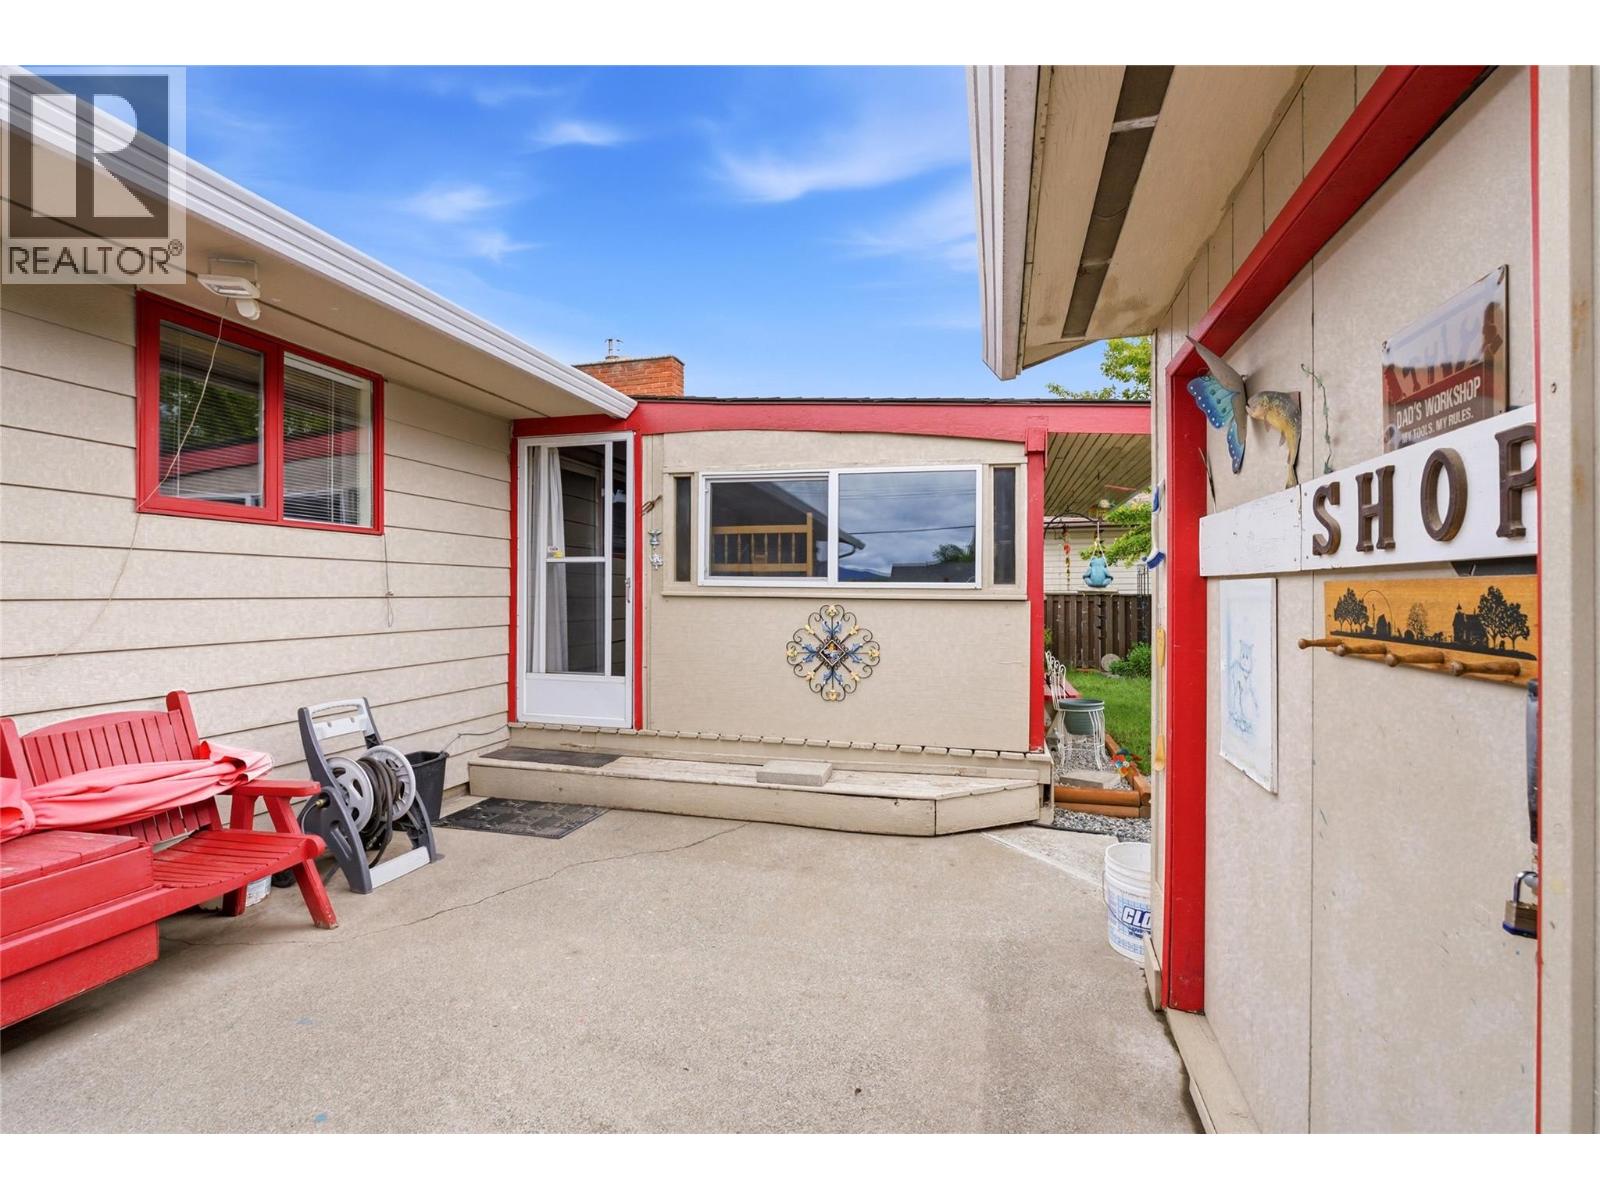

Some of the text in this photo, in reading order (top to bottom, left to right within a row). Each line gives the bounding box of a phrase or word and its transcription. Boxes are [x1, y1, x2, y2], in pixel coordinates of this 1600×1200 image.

[1396, 376, 1481, 429] DAD'S WORKSHOP
[1435, 416, 1448, 432] MY
[1448, 407, 1474, 427] RULES.
[1312, 422, 1537, 556] SHOP
